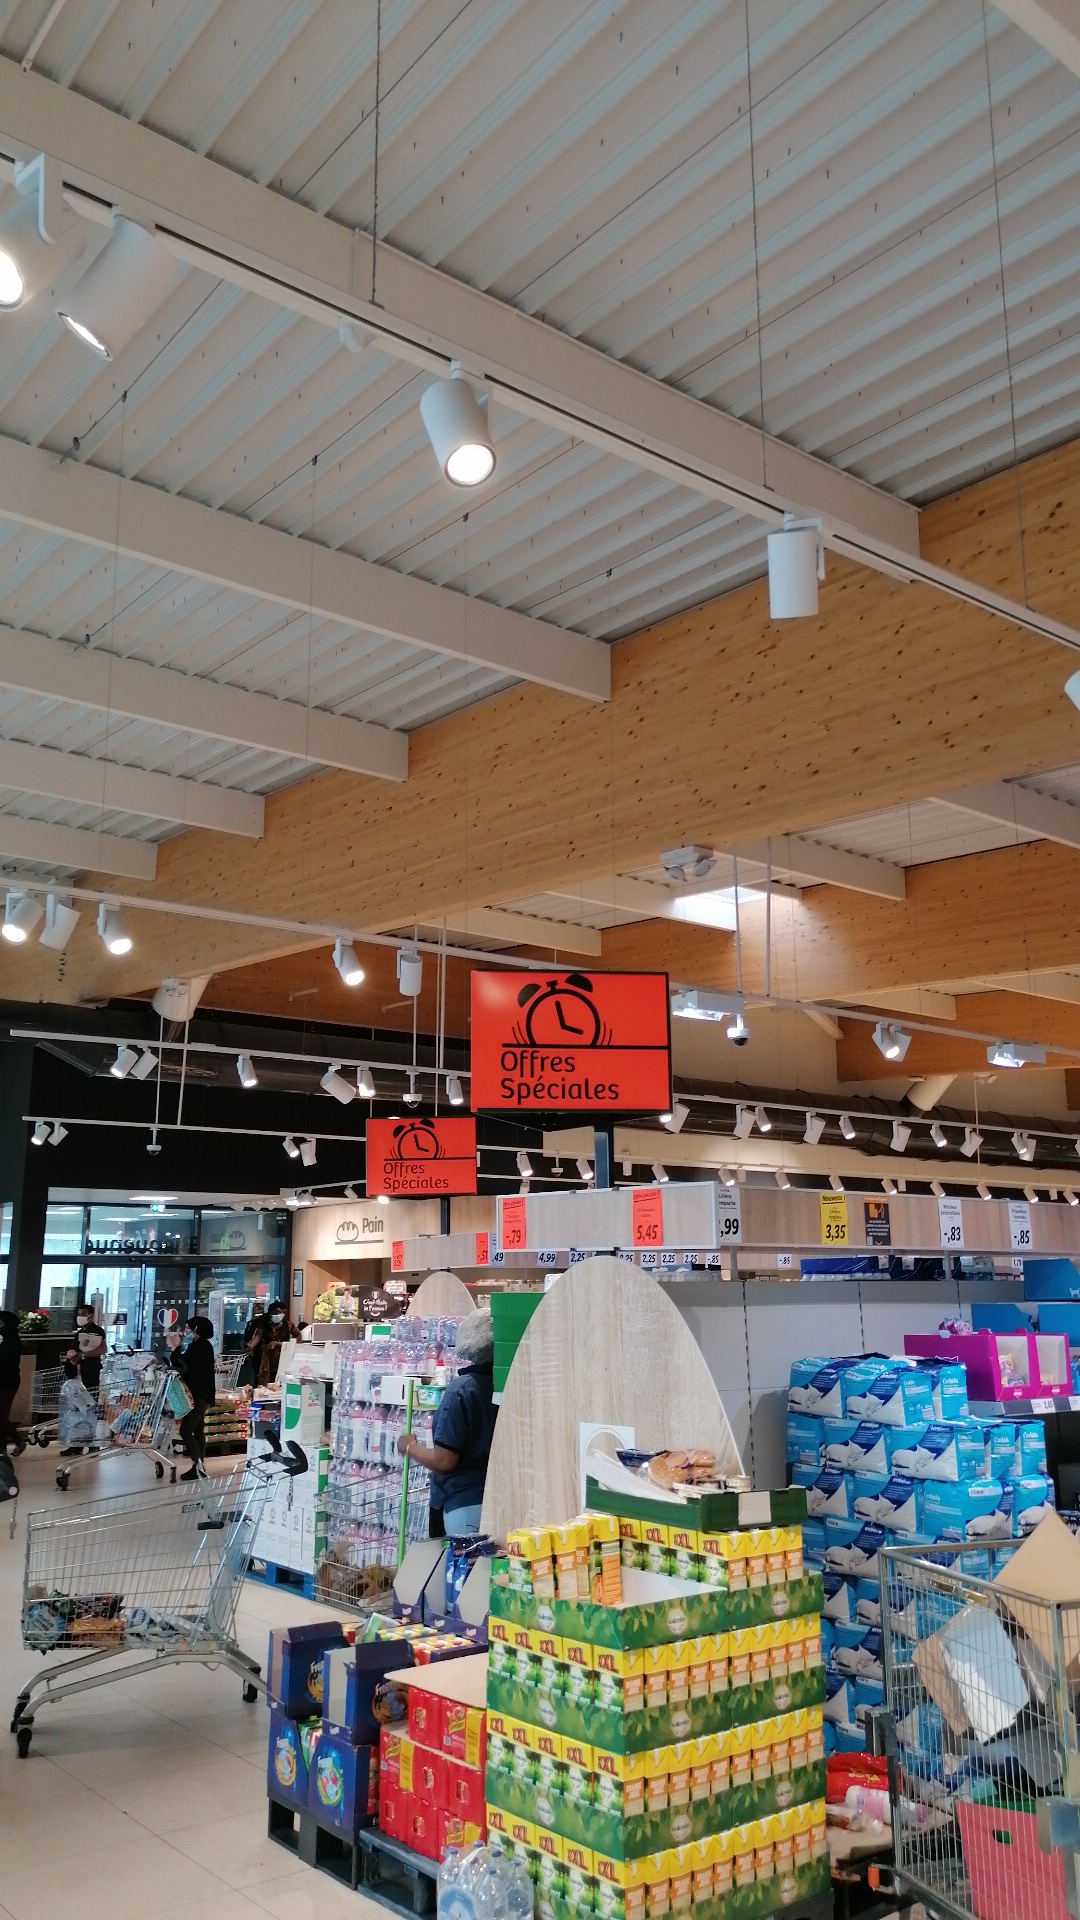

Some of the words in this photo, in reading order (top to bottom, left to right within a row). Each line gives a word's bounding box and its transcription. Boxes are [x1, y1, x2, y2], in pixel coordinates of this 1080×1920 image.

[501, 1050, 576, 1078] Offres
[501, 1075, 620, 1105] Spéciales
[384, 1162, 425, 1178] Offres
[384, 1176, 449, 1192] Spéciales
[362, 1216, 384, 1234] Pain
[637, 1224, 658, 1242] 5,45
[719, 1218, 739, 1237] ,99
[826, 1224, 846, 1241] 3,35
[506, 1230, 521, 1245] -,79
[944, 1226, 960, 1243] -,83
[1014, 1230, 1030, 1245] -,85
[539, 1253, 555, 1262] 4,99
[570, 1253, 585, 1262] 2,25
[642, 1254, 656, 1264] 2,25
[662, 1254, 675, 1264] 2,25
[685, 1254, 697, 1264] 2,25
[646, 1527, 665, 1544] XXL
[673, 1533, 693, 1550] XXL
[702, 1540, 723, 1557] XXL
[492, 1624, 509, 1642] XXL
[514, 1632, 533, 1650] XXL
[539, 1640, 559, 1658] XXL
[567, 1647, 588, 1666] XXL
[598, 1654, 619, 1674] XXL
[490, 1718, 508, 1736] XXL
[512, 1728, 530, 1746] XXL
[538, 1737, 557, 1757] XXL
[566, 1747, 587, 1767] XXL
[598, 1756, 619, 1777] XXL
[489, 1812, 507, 1833] XXL
[512, 1824, 531, 1846] XXL
[539, 1836, 559, 1858] XXL
[567, 1848, 588, 1871] XXL
[598, 1861, 620, 1884] XXL
